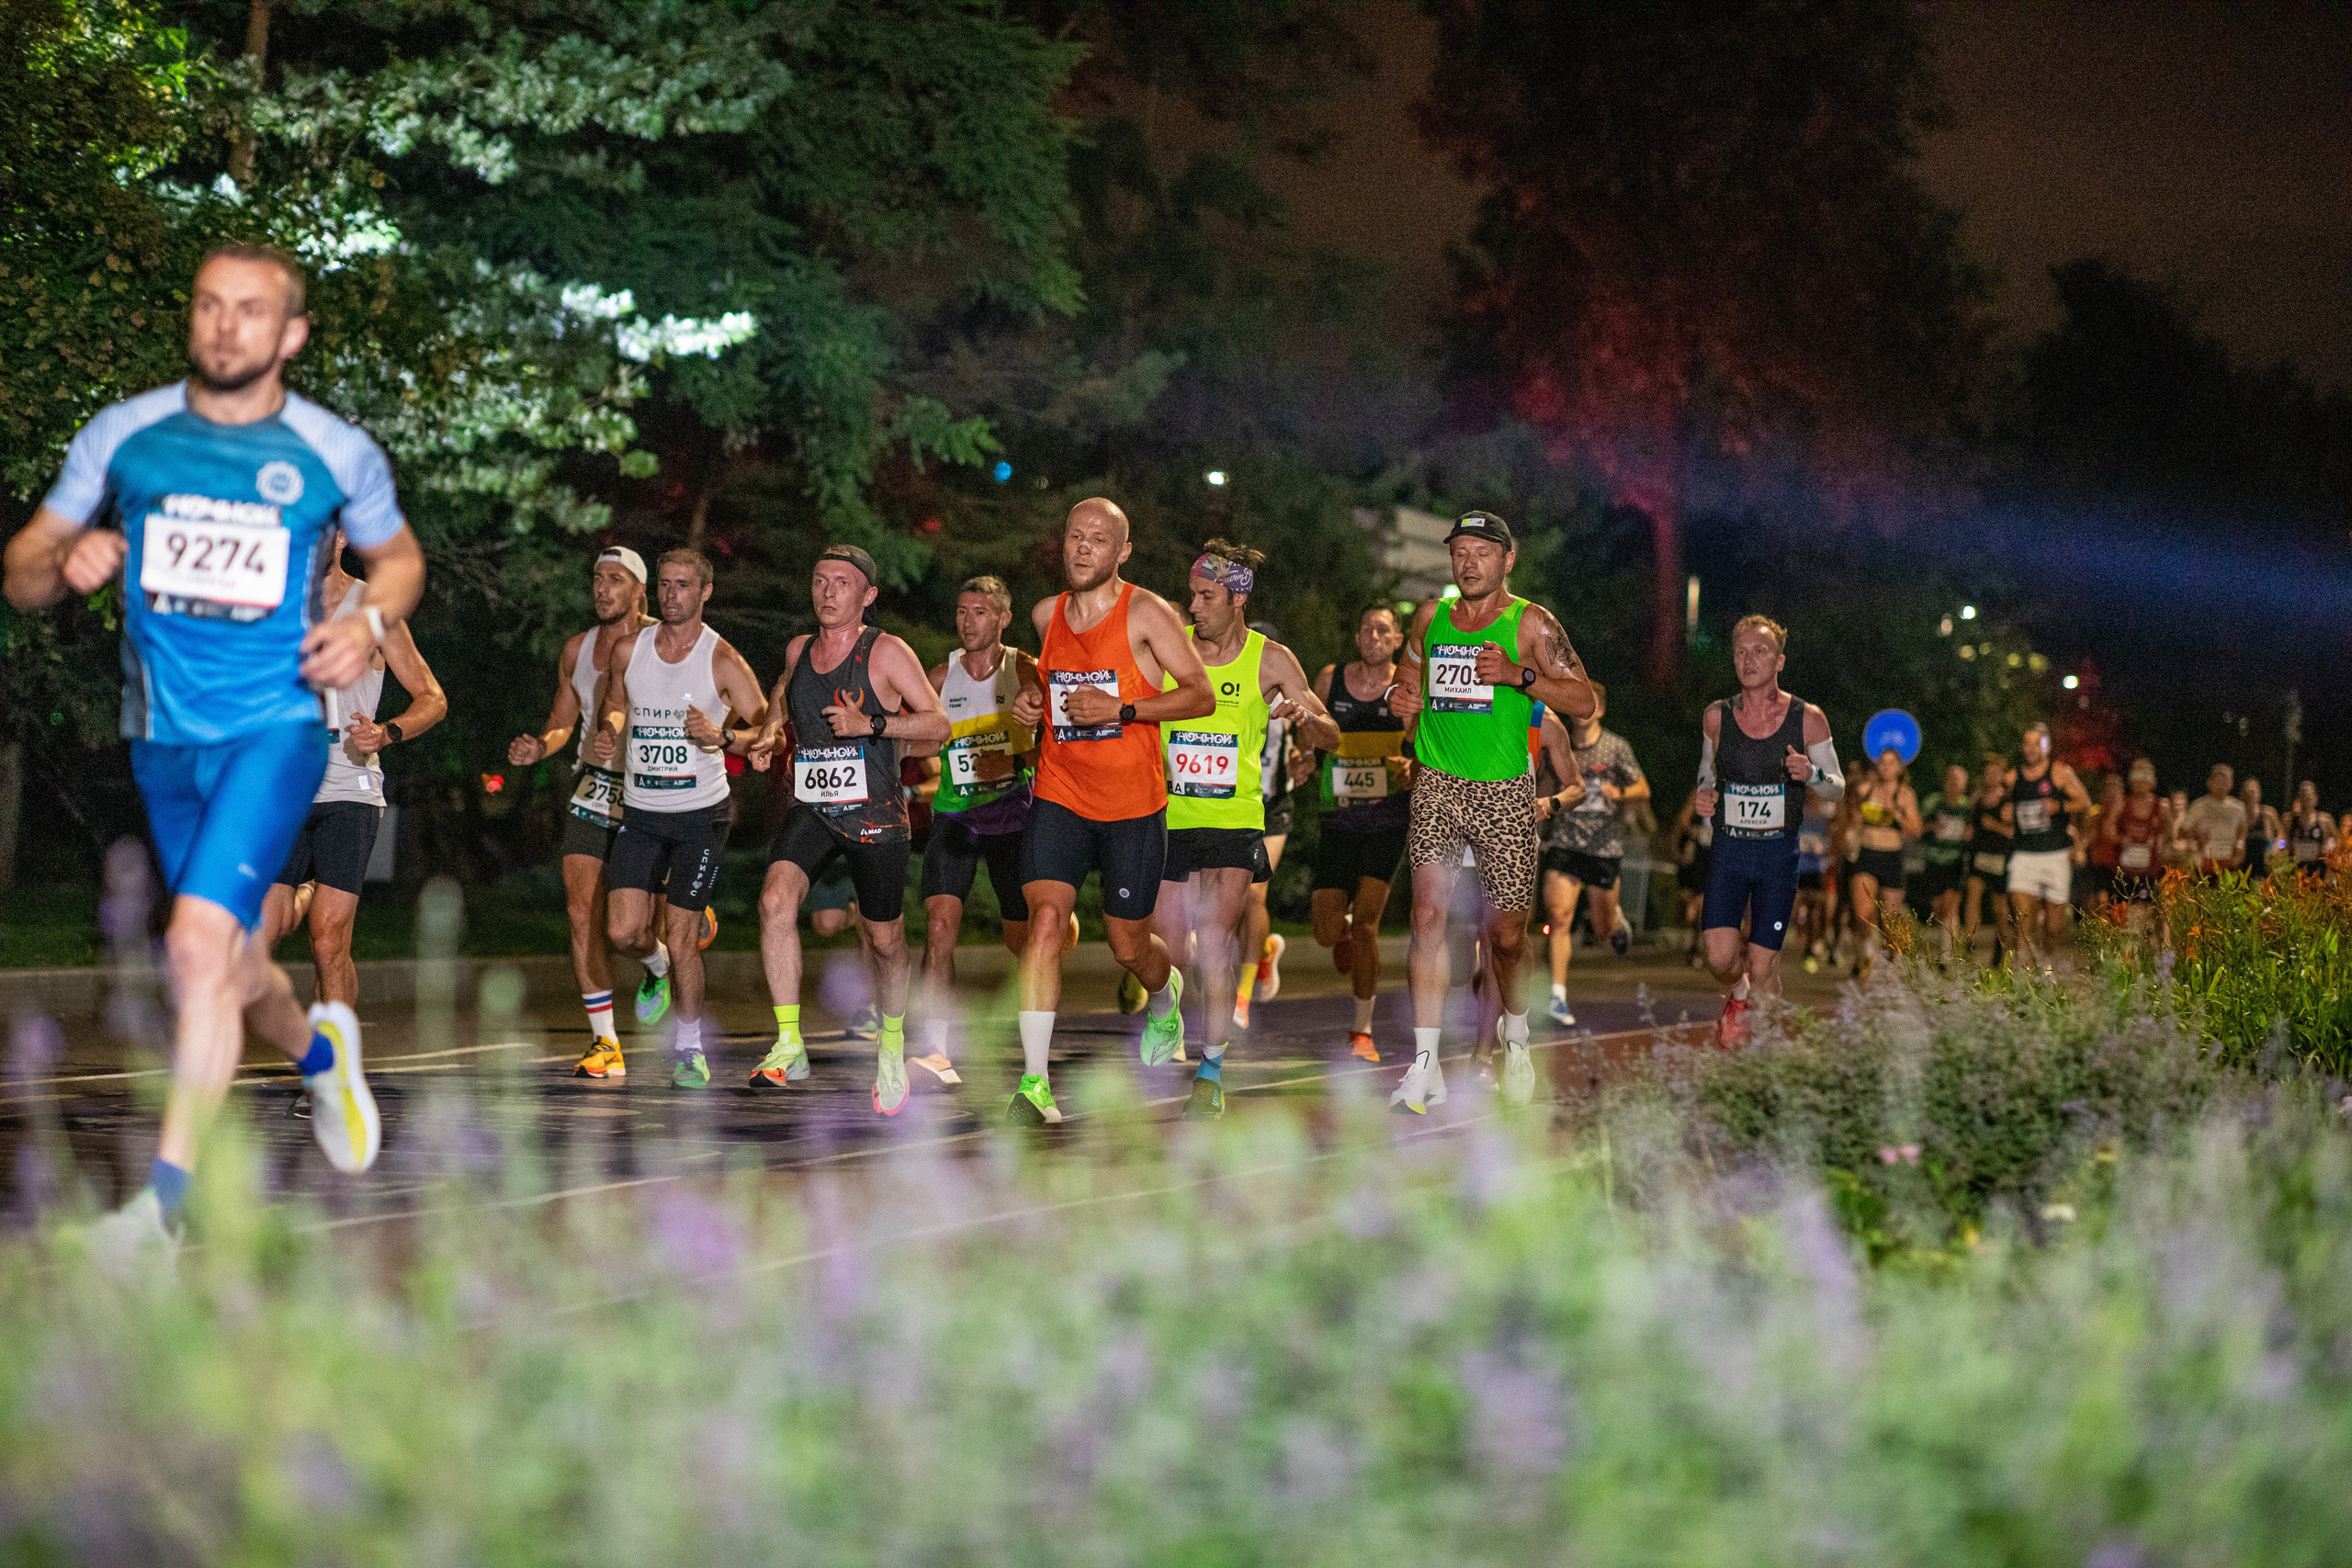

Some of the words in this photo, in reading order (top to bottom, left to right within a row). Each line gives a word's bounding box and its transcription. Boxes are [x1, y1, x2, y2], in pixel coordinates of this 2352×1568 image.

[167, 531, 265, 576] 9274
[1438, 645, 1484, 657] НОЧНО
[1056, 670, 1112, 683] НОЧНОЙ
[1221, 682, 1240, 697] O!
[1444, 686, 1472, 694] МИХАИЛ
[1177, 731, 1234, 745] НОЧНОЙ
[639, 744, 688, 764] 3708
[803, 746, 858, 760] НОЧНОЙ
[1176, 753, 1229, 775] 9619
[805, 766, 857, 789] 6862
[1344, 773, 1375, 788] 445
[583, 782, 626, 807] 2758
[1737, 801, 1772, 818] 174
